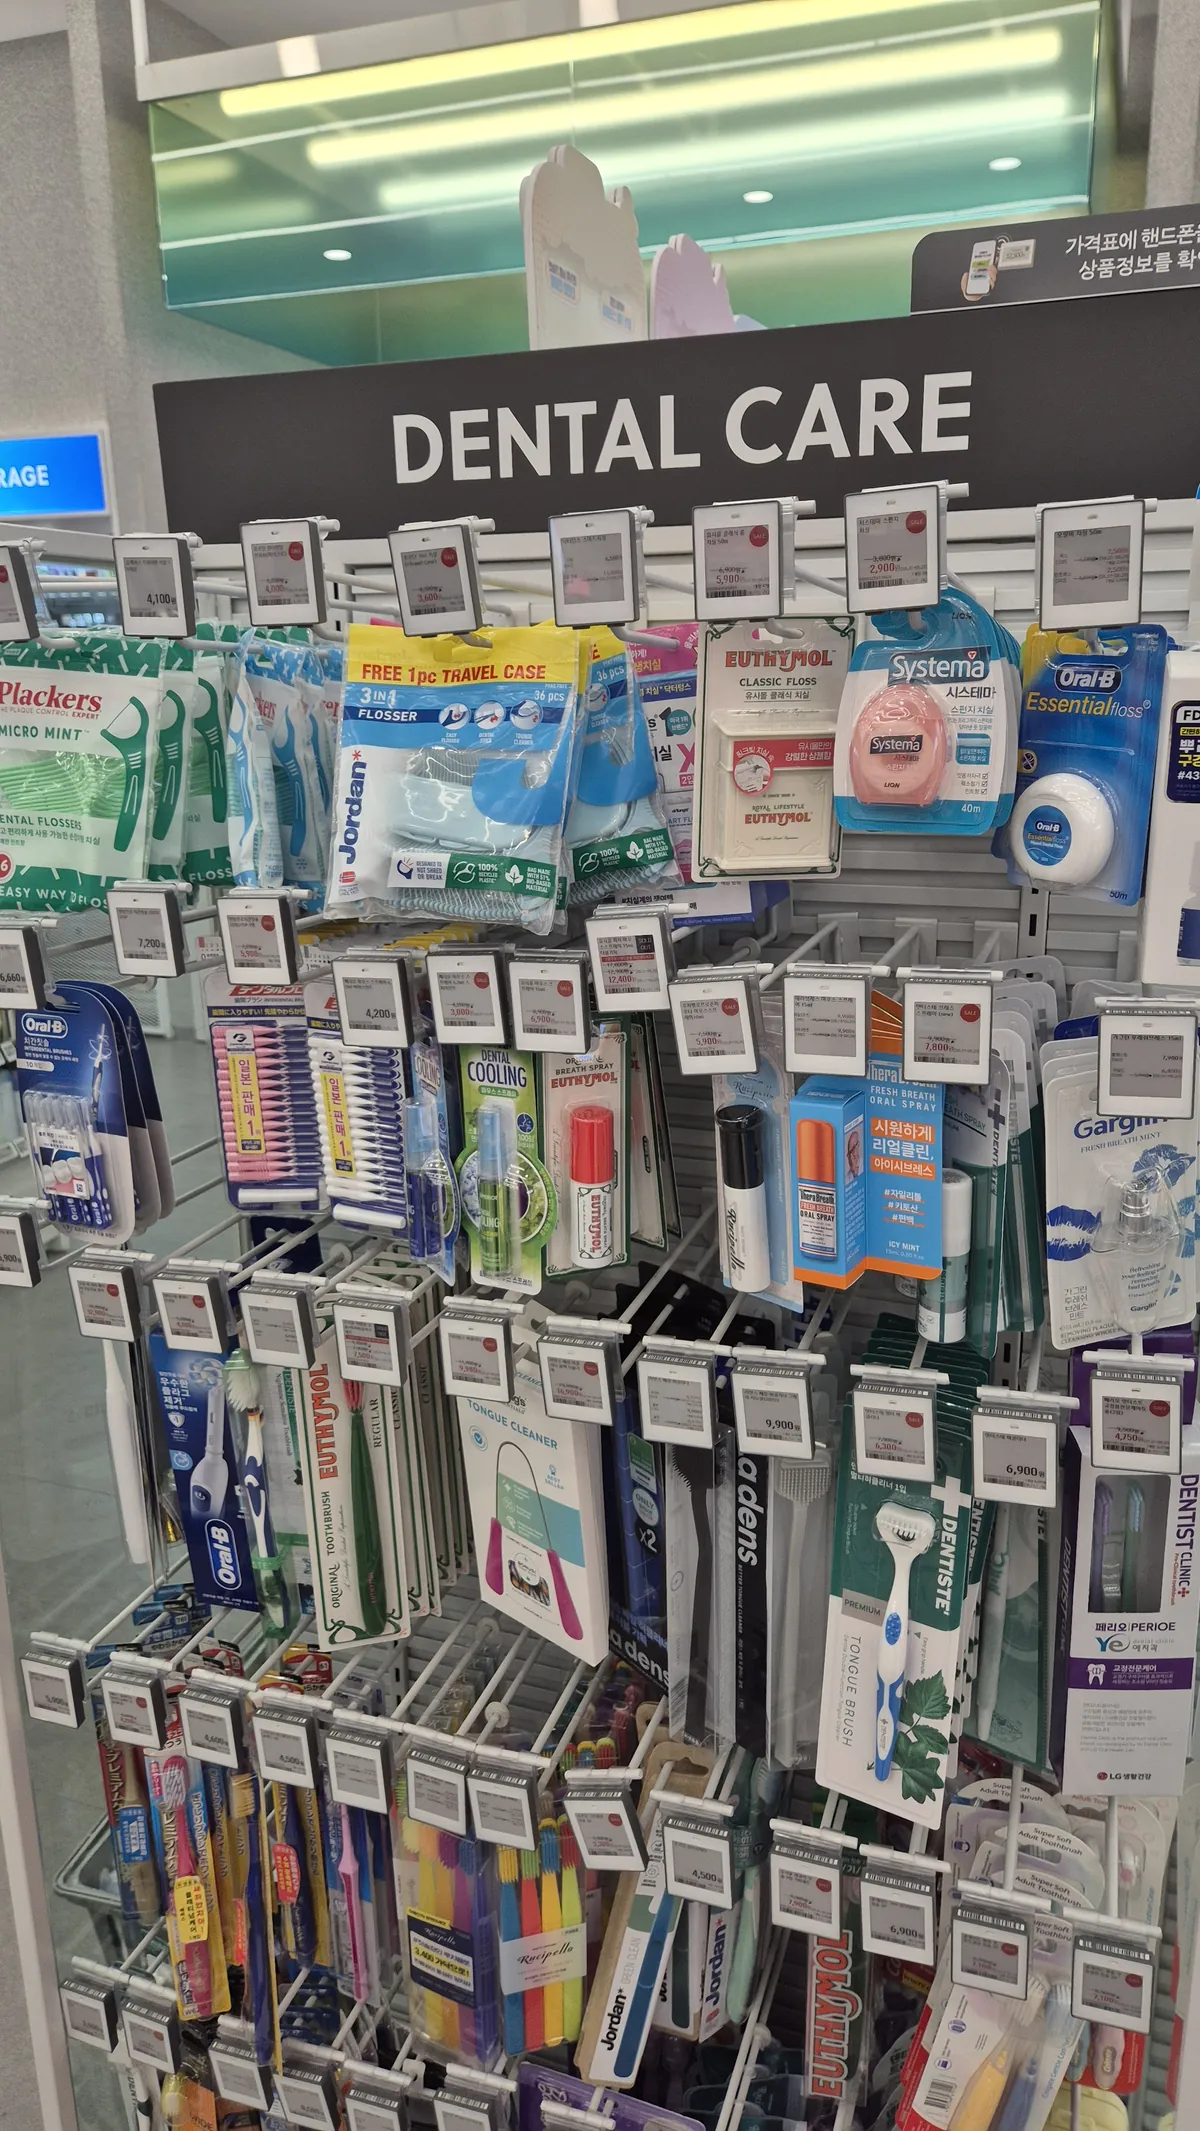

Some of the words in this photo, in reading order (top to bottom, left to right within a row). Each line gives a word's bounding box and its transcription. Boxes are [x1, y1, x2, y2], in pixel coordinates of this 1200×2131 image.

[1066, 233, 1136, 257] 가격표에
[1079, 254, 1172, 280] 상품정보를
[393, 395, 700, 484] DENTAL
[725, 371, 972, 464] CARE
[725, 650, 832, 672] EUTHYMOL
[892, 654, 985, 682] Systema
[363, 664, 402, 681] FREE
[408, 667, 436, 686] 1pc
[442, 664, 498, 683] TRAVEL
[504, 664, 546, 680] CASE
[597, 670, 608, 682] 36
[610, 666, 624, 681] pcs
[739, 678, 782, 686] CLASSIC
[786, 677, 817, 686] FLOSS
[1059, 668, 1116, 688] Oral-B
[0, 681, 102, 713] Plackers
[534, 690, 547, 700] 36
[548, 692, 565, 703] pcs
[745, 691, 767, 700] 유시몰
[770, 691, 792, 699] 클래식
[795, 690, 810, 699] 치실
[946, 686, 997, 699] 시스테마
[72, 712, 99, 720] EXPERT
[358, 709, 417, 722] FLOSSER
[950, 706, 976, 714] 스펀지
[977, 705, 994, 714] 치실
[0, 725, 38, 738] MICRO
[44, 728, 82, 741] MINT
[798, 742, 831, 750] 유시몰만의
[872, 737, 921, 751] Systema
[785, 752, 807, 762] 강렬한
[808, 751, 831, 760] 상쾌함
[338, 760, 368, 865] Jordan
[961, 804, 981, 813] 40m
[38, 817, 82, 830] FLOSSERS
[745, 812, 811, 826] EUTHYMOL
[1036, 822, 1060, 831] Oral-B
[8, 828, 34, 837] 편리하게
[35, 829, 47, 837] 사용
[50, 830, 68, 841] 가능한
[86, 835, 100, 845] 치실
[428, 867, 442, 875] SHRED
[478, 863, 498, 872] 100%
[526, 878, 551, 887] BIO-BASED
[526, 884, 548, 893] MATERIAL
[0, 887, 31, 898] EASY
[36, 888, 65, 900] WAY
[1109, 890, 1128, 900] 50m
[25, 1017, 66, 1034] Oral-B
[24, 1037, 49, 1048] 치간칫솔
[24, 1046, 52, 1055] INTERDENTAL
[53, 1048, 72, 1056] BRUSHES
[481, 1049, 510, 1065] DENTAL
[239, 1059, 252, 1086] 일본
[467, 1062, 527, 1088] COOLING
[555, 1065, 587, 1076] BREATH
[588, 1062, 614, 1072] SPRAY
[551, 1071, 618, 1089] EUTHYMOL
[329, 1077, 343, 1105] 일본
[480, 1087, 496, 1096] 마우스
[497, 1088, 518, 1098] 스프레이
[870, 1085, 897, 1097] FRESH
[901, 1088, 936, 1101] BREATH
[242, 1091, 256, 1116] 판매
[869, 1095, 896, 1108] ORAL
[902, 1100, 937, 1113] SPRAY
[334, 1111, 346, 1137] 판매
[874, 1120, 932, 1142] 시원하게
[963, 1113, 987, 1132] SPRAY
[872, 1138, 934, 1161] 리얼클린,
[1081, 1142, 1106, 1153] FRESH
[1107, 1136, 1138, 1149] BREATH
[1139, 1132, 1162, 1142] MINT
[874, 1157, 933, 1177] 아이시브레스
[800, 1209, 815, 1219] ORAL
[816, 1211, 835, 1222] SPRAY
[816, 1203, 835, 1213] BREATH
[888, 1201, 918, 1213] #키토산
[591, 1195, 601, 1253] EUTHYMOL
[888, 1240, 900, 1249] ICY
[902, 1241, 920, 1252] MINT
[1129, 1261, 1161, 1273] Refreshing
[1064, 1285, 1088, 1296] 가그린
[1065, 1303, 1088, 1313] 브레스
[1130, 1301, 1157, 1312] Garglin
[1069, 1311, 1085, 1321] 민트
[1060, 1327, 1090, 1339] REMOVING
[1092, 1322, 1115, 1333] PLAQUE
[160, 1377, 189, 1389] 우수한
[162, 1385, 191, 1397] 플라그
[163, 1395, 183, 1406] 제거
[309, 1363, 339, 1480] EUTHYMOL
[372, 1398, 382, 1449] REGULAR
[467, 1399, 508, 1428] TONGUE
[510, 1421, 558, 1451] CLEANER
[1006, 1463, 1046, 1478] 6,900원
[1176, 1474, 1199, 1550] DENTIST
[321, 1491, 335, 1556] TOOTHBRUSH
[738, 1488, 764, 1566] dens
[210, 1526, 236, 1586] Oral-B
[1178, 1551, 1193, 1587] CLINIC
[328, 1562, 341, 1609] ORIGINAL
[843, 1598, 882, 1617] PREMIUM
[1095, 1622, 1127, 1632] 페리오
[1131, 1621, 1176, 1632] PERIOE
[625, 1640, 670, 1688] dens
[850, 1635, 862, 1679] TONGUE
[1113, 1663, 1157, 1673] 교정전문케어
[842, 1687, 856, 1748] BRUSH
[1123, 1773, 1152, 1781] 생활건강
[980, 1787, 1001, 1795] Adult
[1018, 1830, 1039, 1842] Adult
[1040, 1837, 1082, 1856] Toothbrush
[1034, 1827, 1051, 1838] Super
[1053, 1835, 1072, 1845] Soft
[1015, 1875, 1036, 1887] Adult
[1037, 1886, 1082, 1907] Toothbrush
[1031, 1874, 1049, 1886] Super
[1052, 1884, 1071, 1896] Soft
[424, 1927, 456, 1945] Rucipello
[1050, 1922, 1070, 1933] Soft
[517, 1941, 573, 1966] Rucipello
[627, 1937, 641, 1963] CLEAN
[621, 1961, 634, 1986] GREEN
[706, 1924, 727, 2006] Jordan
[601, 1995, 627, 2051] Jordan
[812, 1931, 862, 2098] EUTHYMOL
